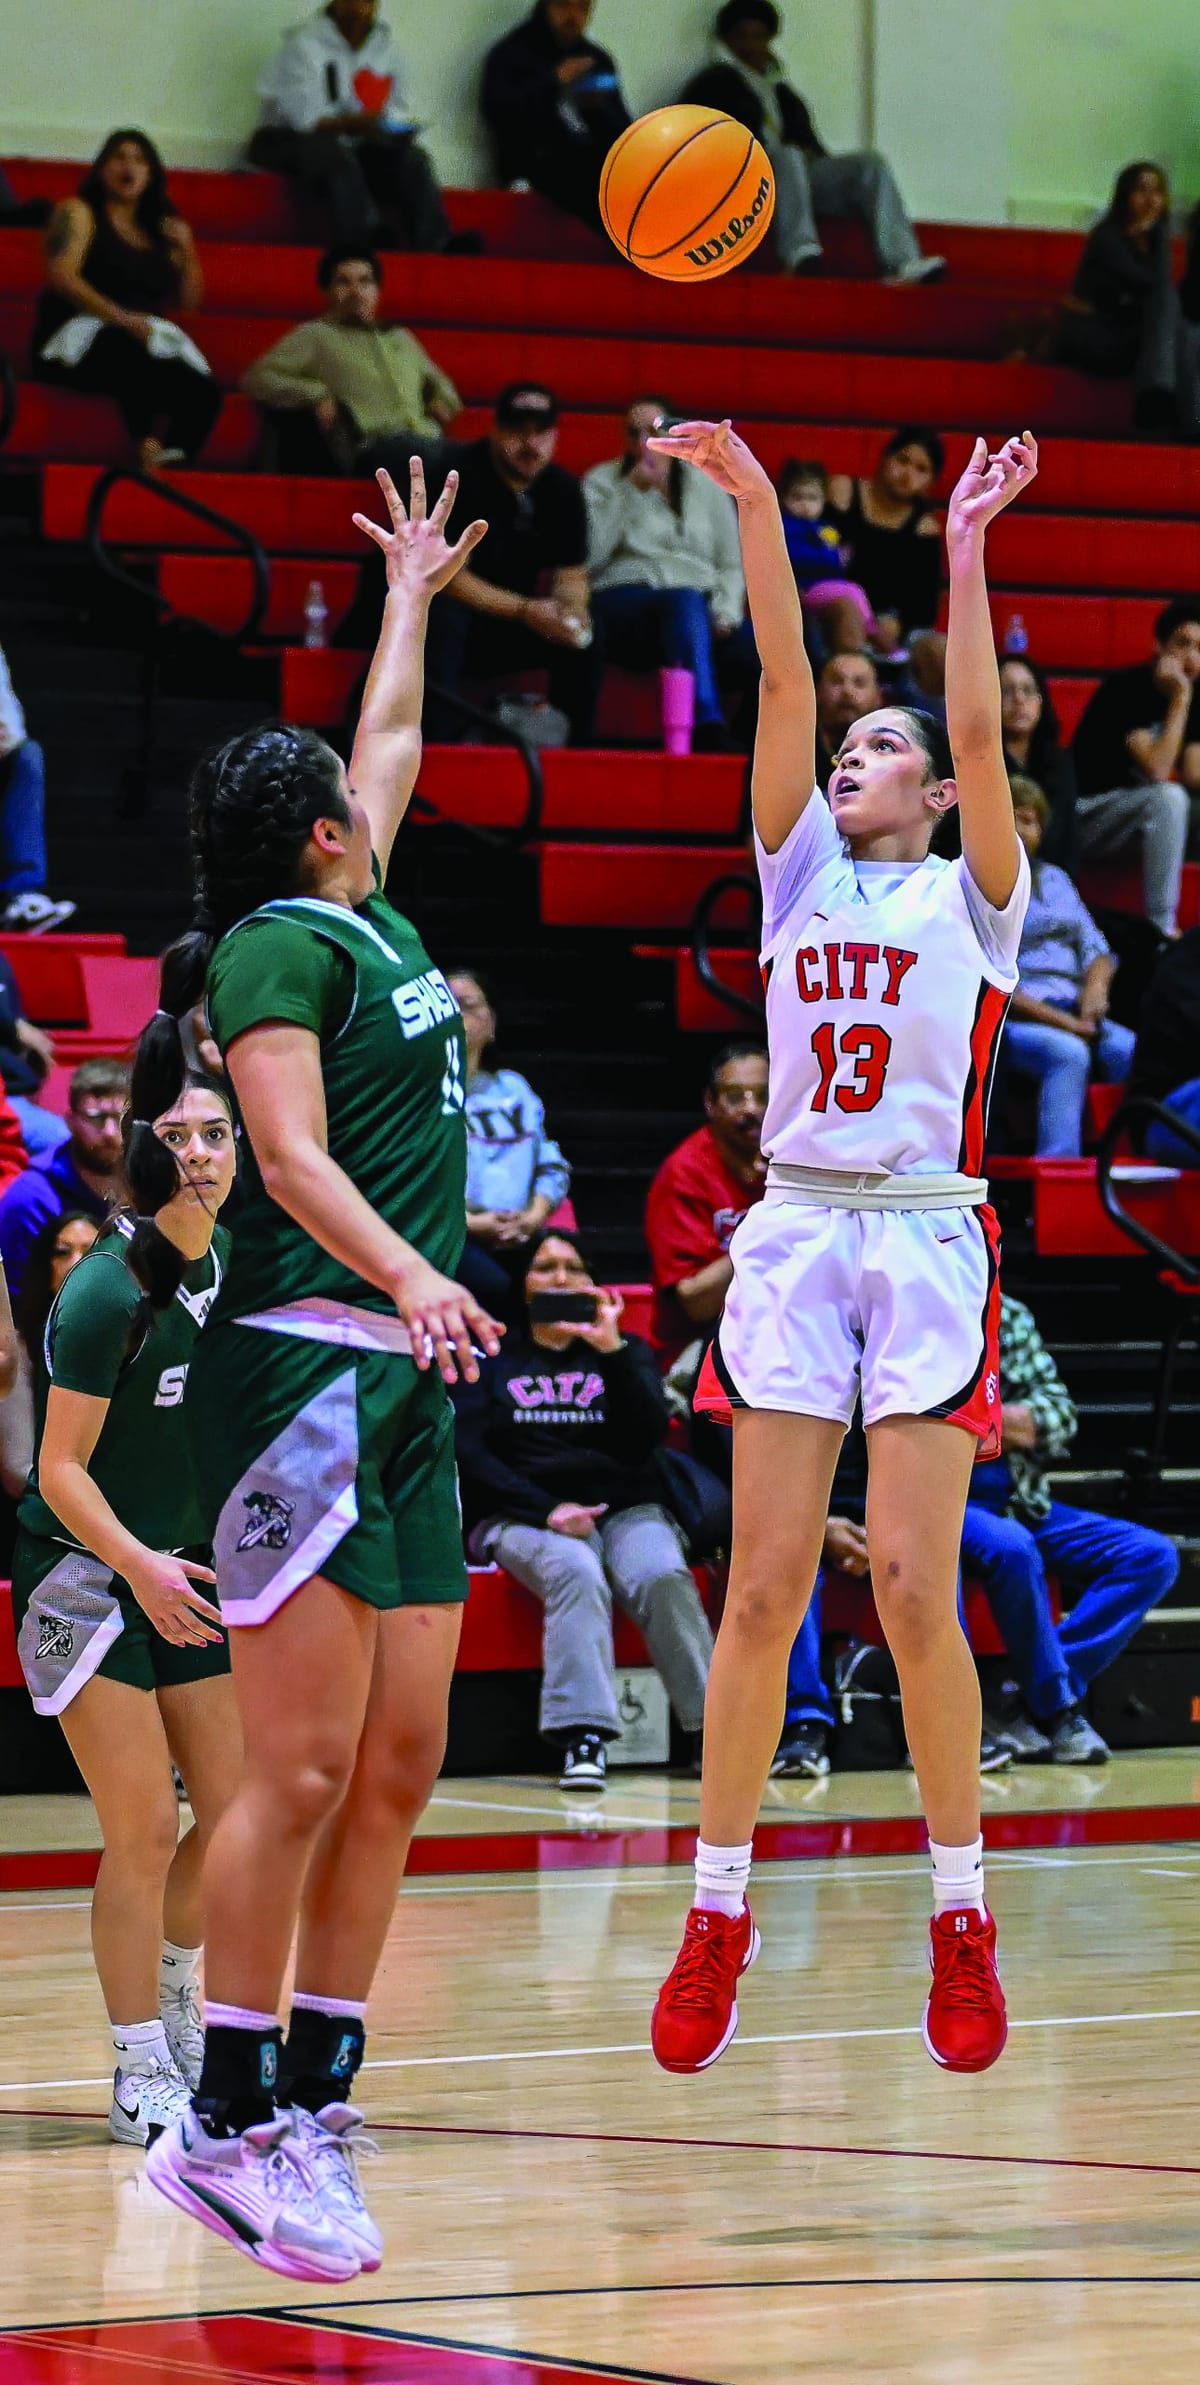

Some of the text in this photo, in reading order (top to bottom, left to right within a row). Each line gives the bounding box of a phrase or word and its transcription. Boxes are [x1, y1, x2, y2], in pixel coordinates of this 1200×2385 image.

[683, 176, 769, 266] Wilson
[796, 942, 918, 1006] CITY
[810, 1022, 892, 1113] 13
[153, 1363, 190, 1407] S
